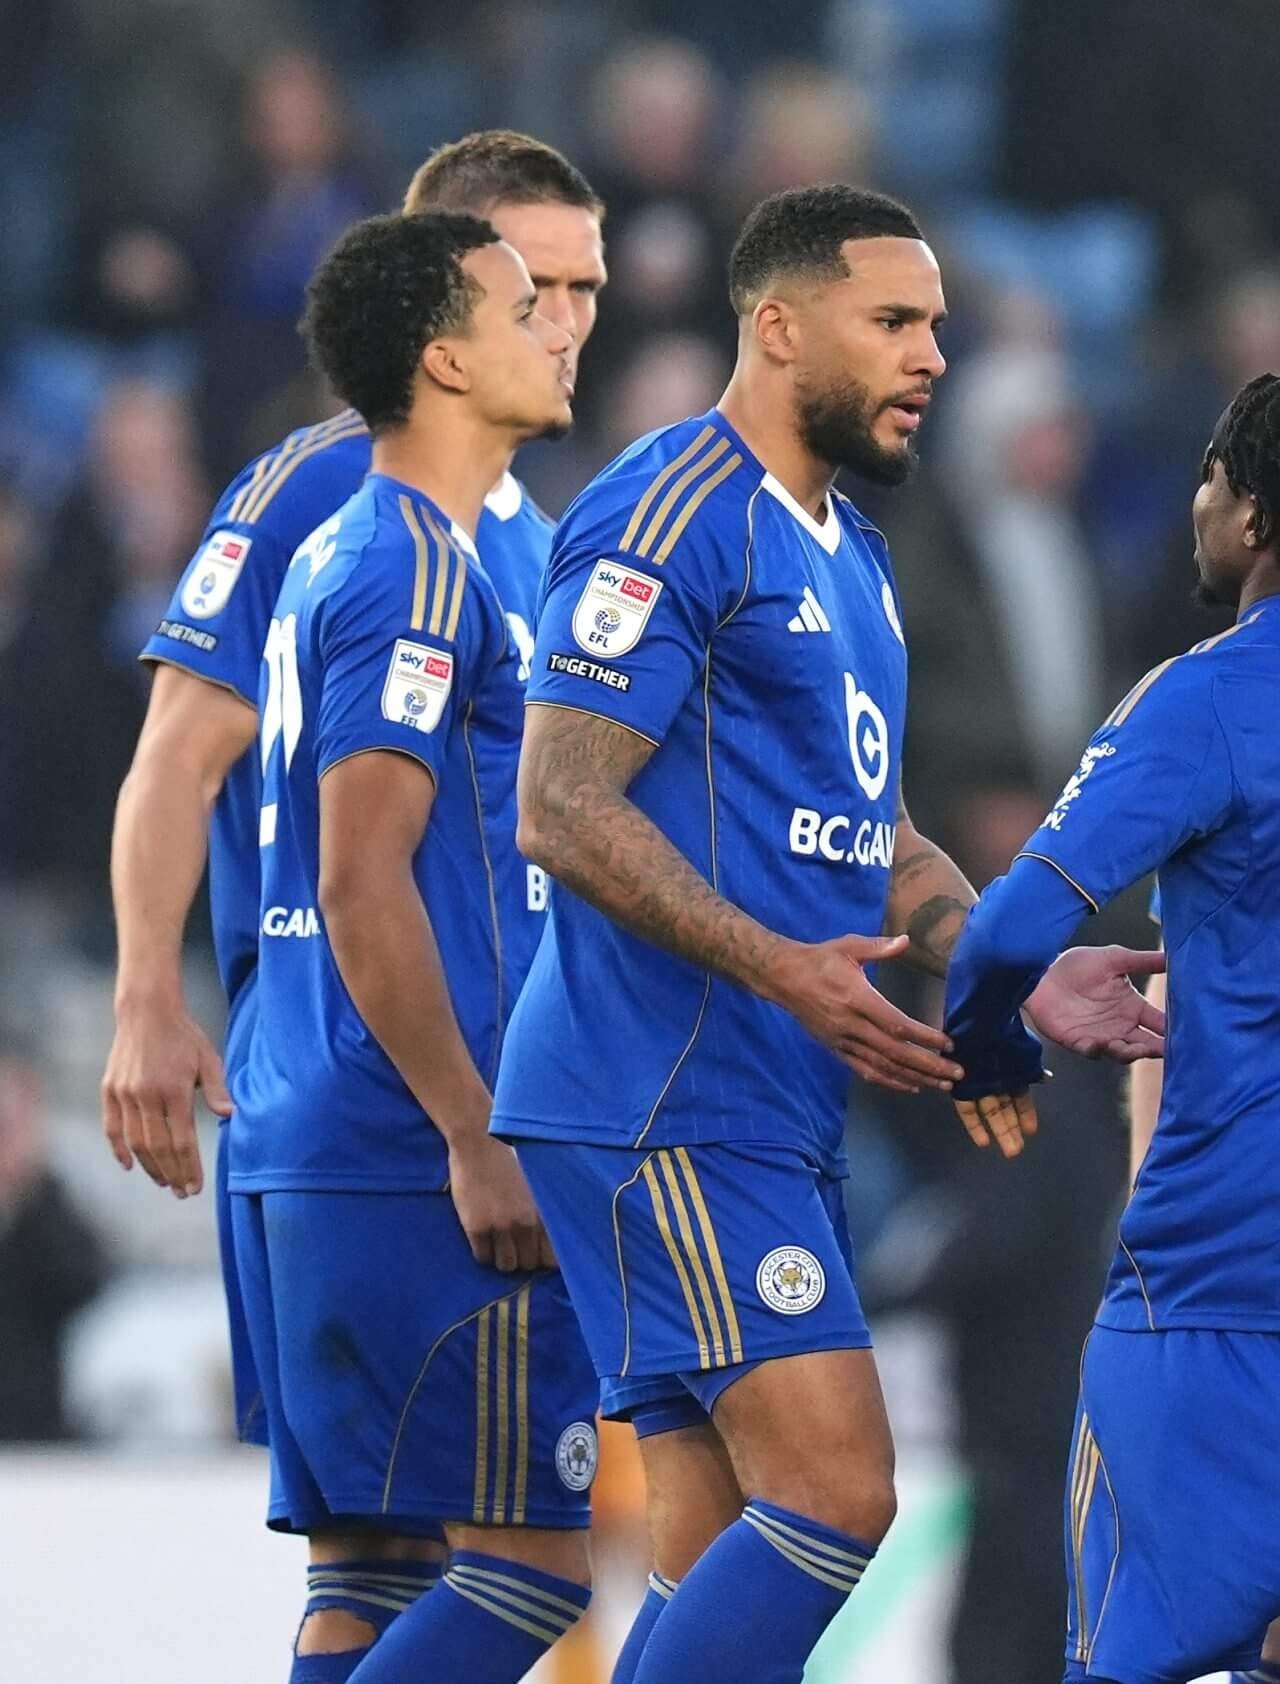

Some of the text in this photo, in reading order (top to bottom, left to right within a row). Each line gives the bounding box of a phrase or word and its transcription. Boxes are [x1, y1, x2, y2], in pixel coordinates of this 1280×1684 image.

[598, 571, 651, 599] sky bet
[589, 631, 608, 648] EFL
[400, 651, 424, 669] sky
[551, 654, 629, 691] TOGETHER
